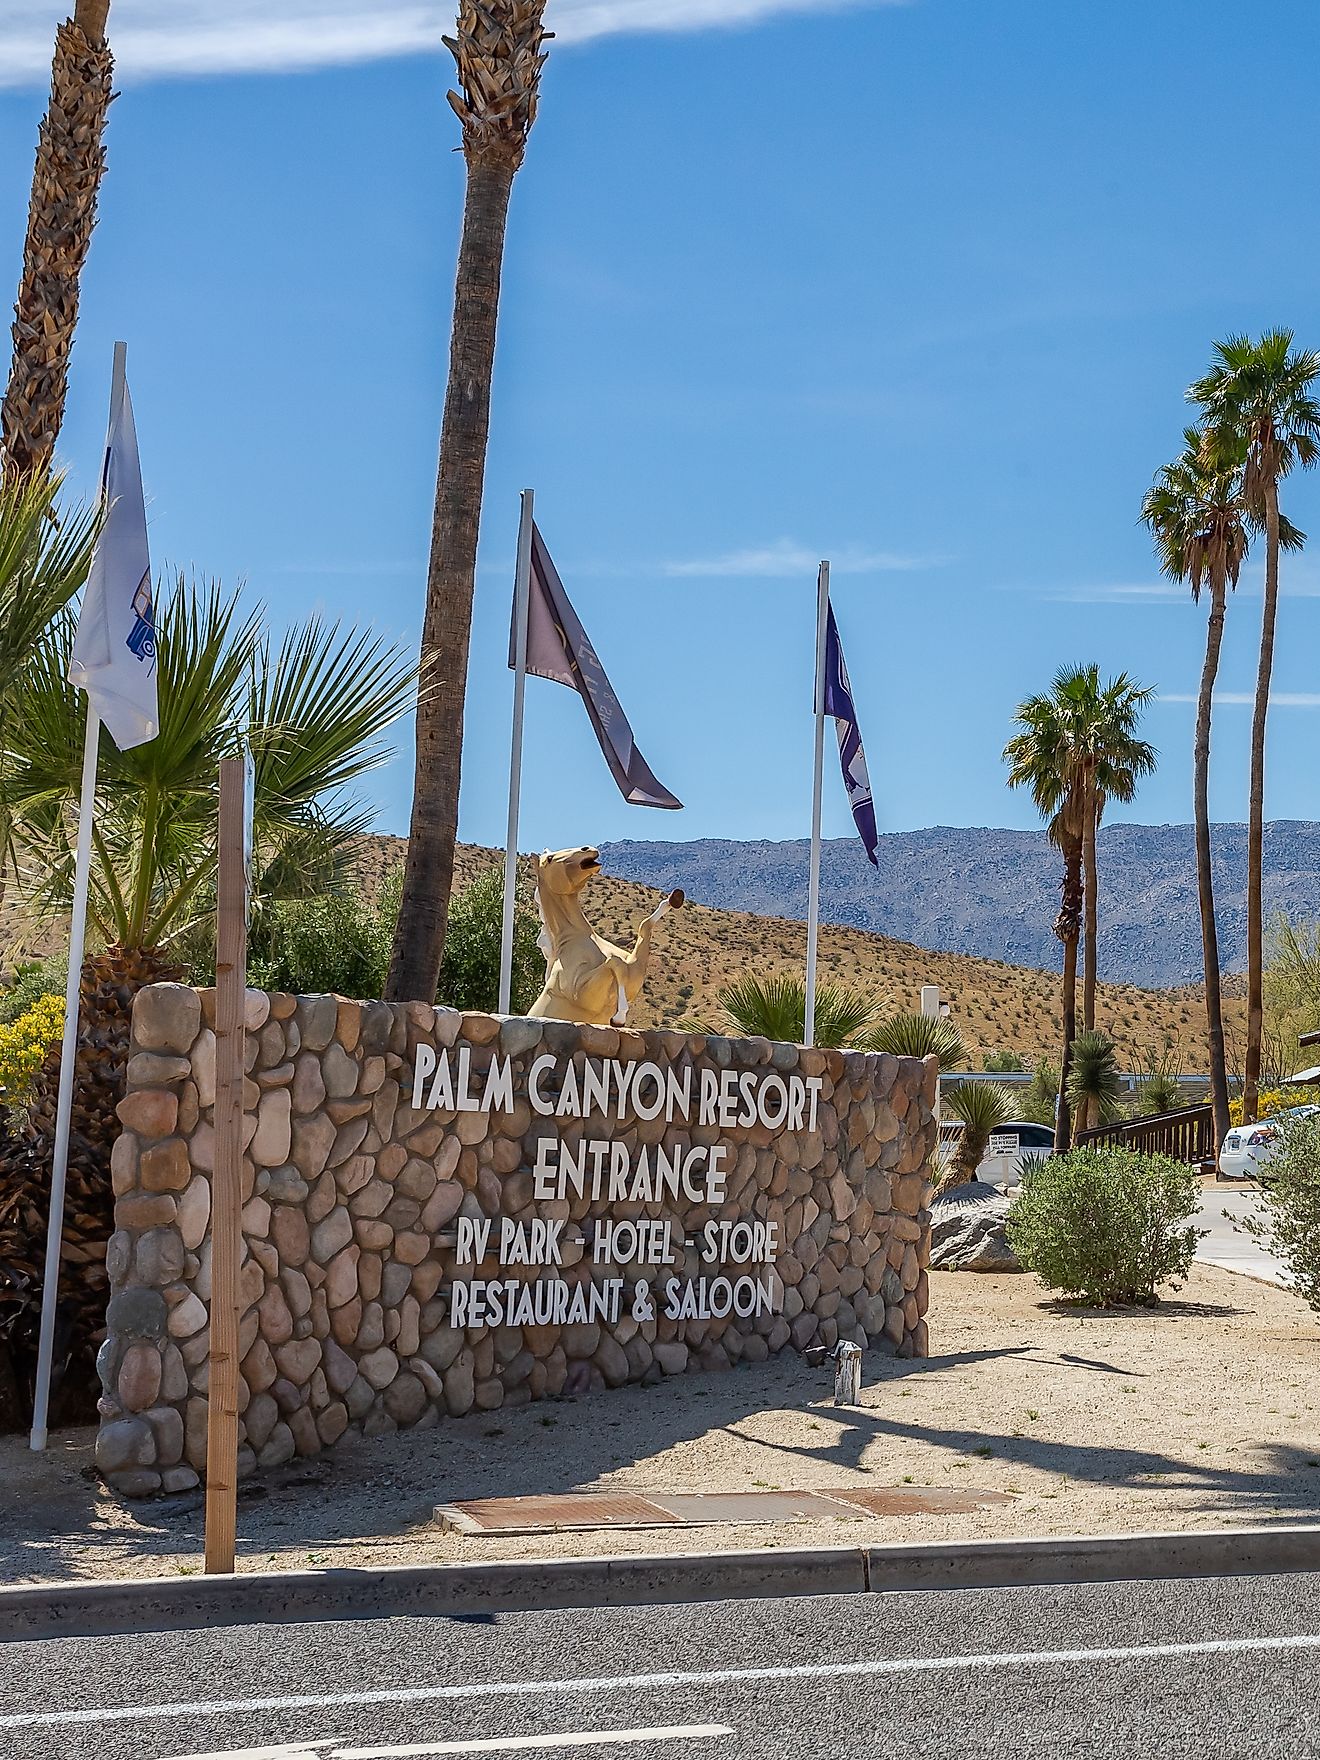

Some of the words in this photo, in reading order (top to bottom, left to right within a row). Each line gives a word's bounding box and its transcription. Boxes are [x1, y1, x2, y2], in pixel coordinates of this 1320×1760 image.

[411, 1043, 515, 1115] PALM
[528, 1053, 692, 1123] CANYON
[698, 1068, 824, 1133] RESORT
[532, 1137, 728, 1205] ENTRANCE
[455, 1216, 493, 1265] RV
[500, 1217, 564, 1266] PARK
[593, 1219, 676, 1265] HOTEL
[702, 1220, 779, 1264] STORE
[450, 1277, 624, 1330] RESTAURANT
[631, 1280, 654, 1323] &
[663, 1275, 775, 1322] SALOON
